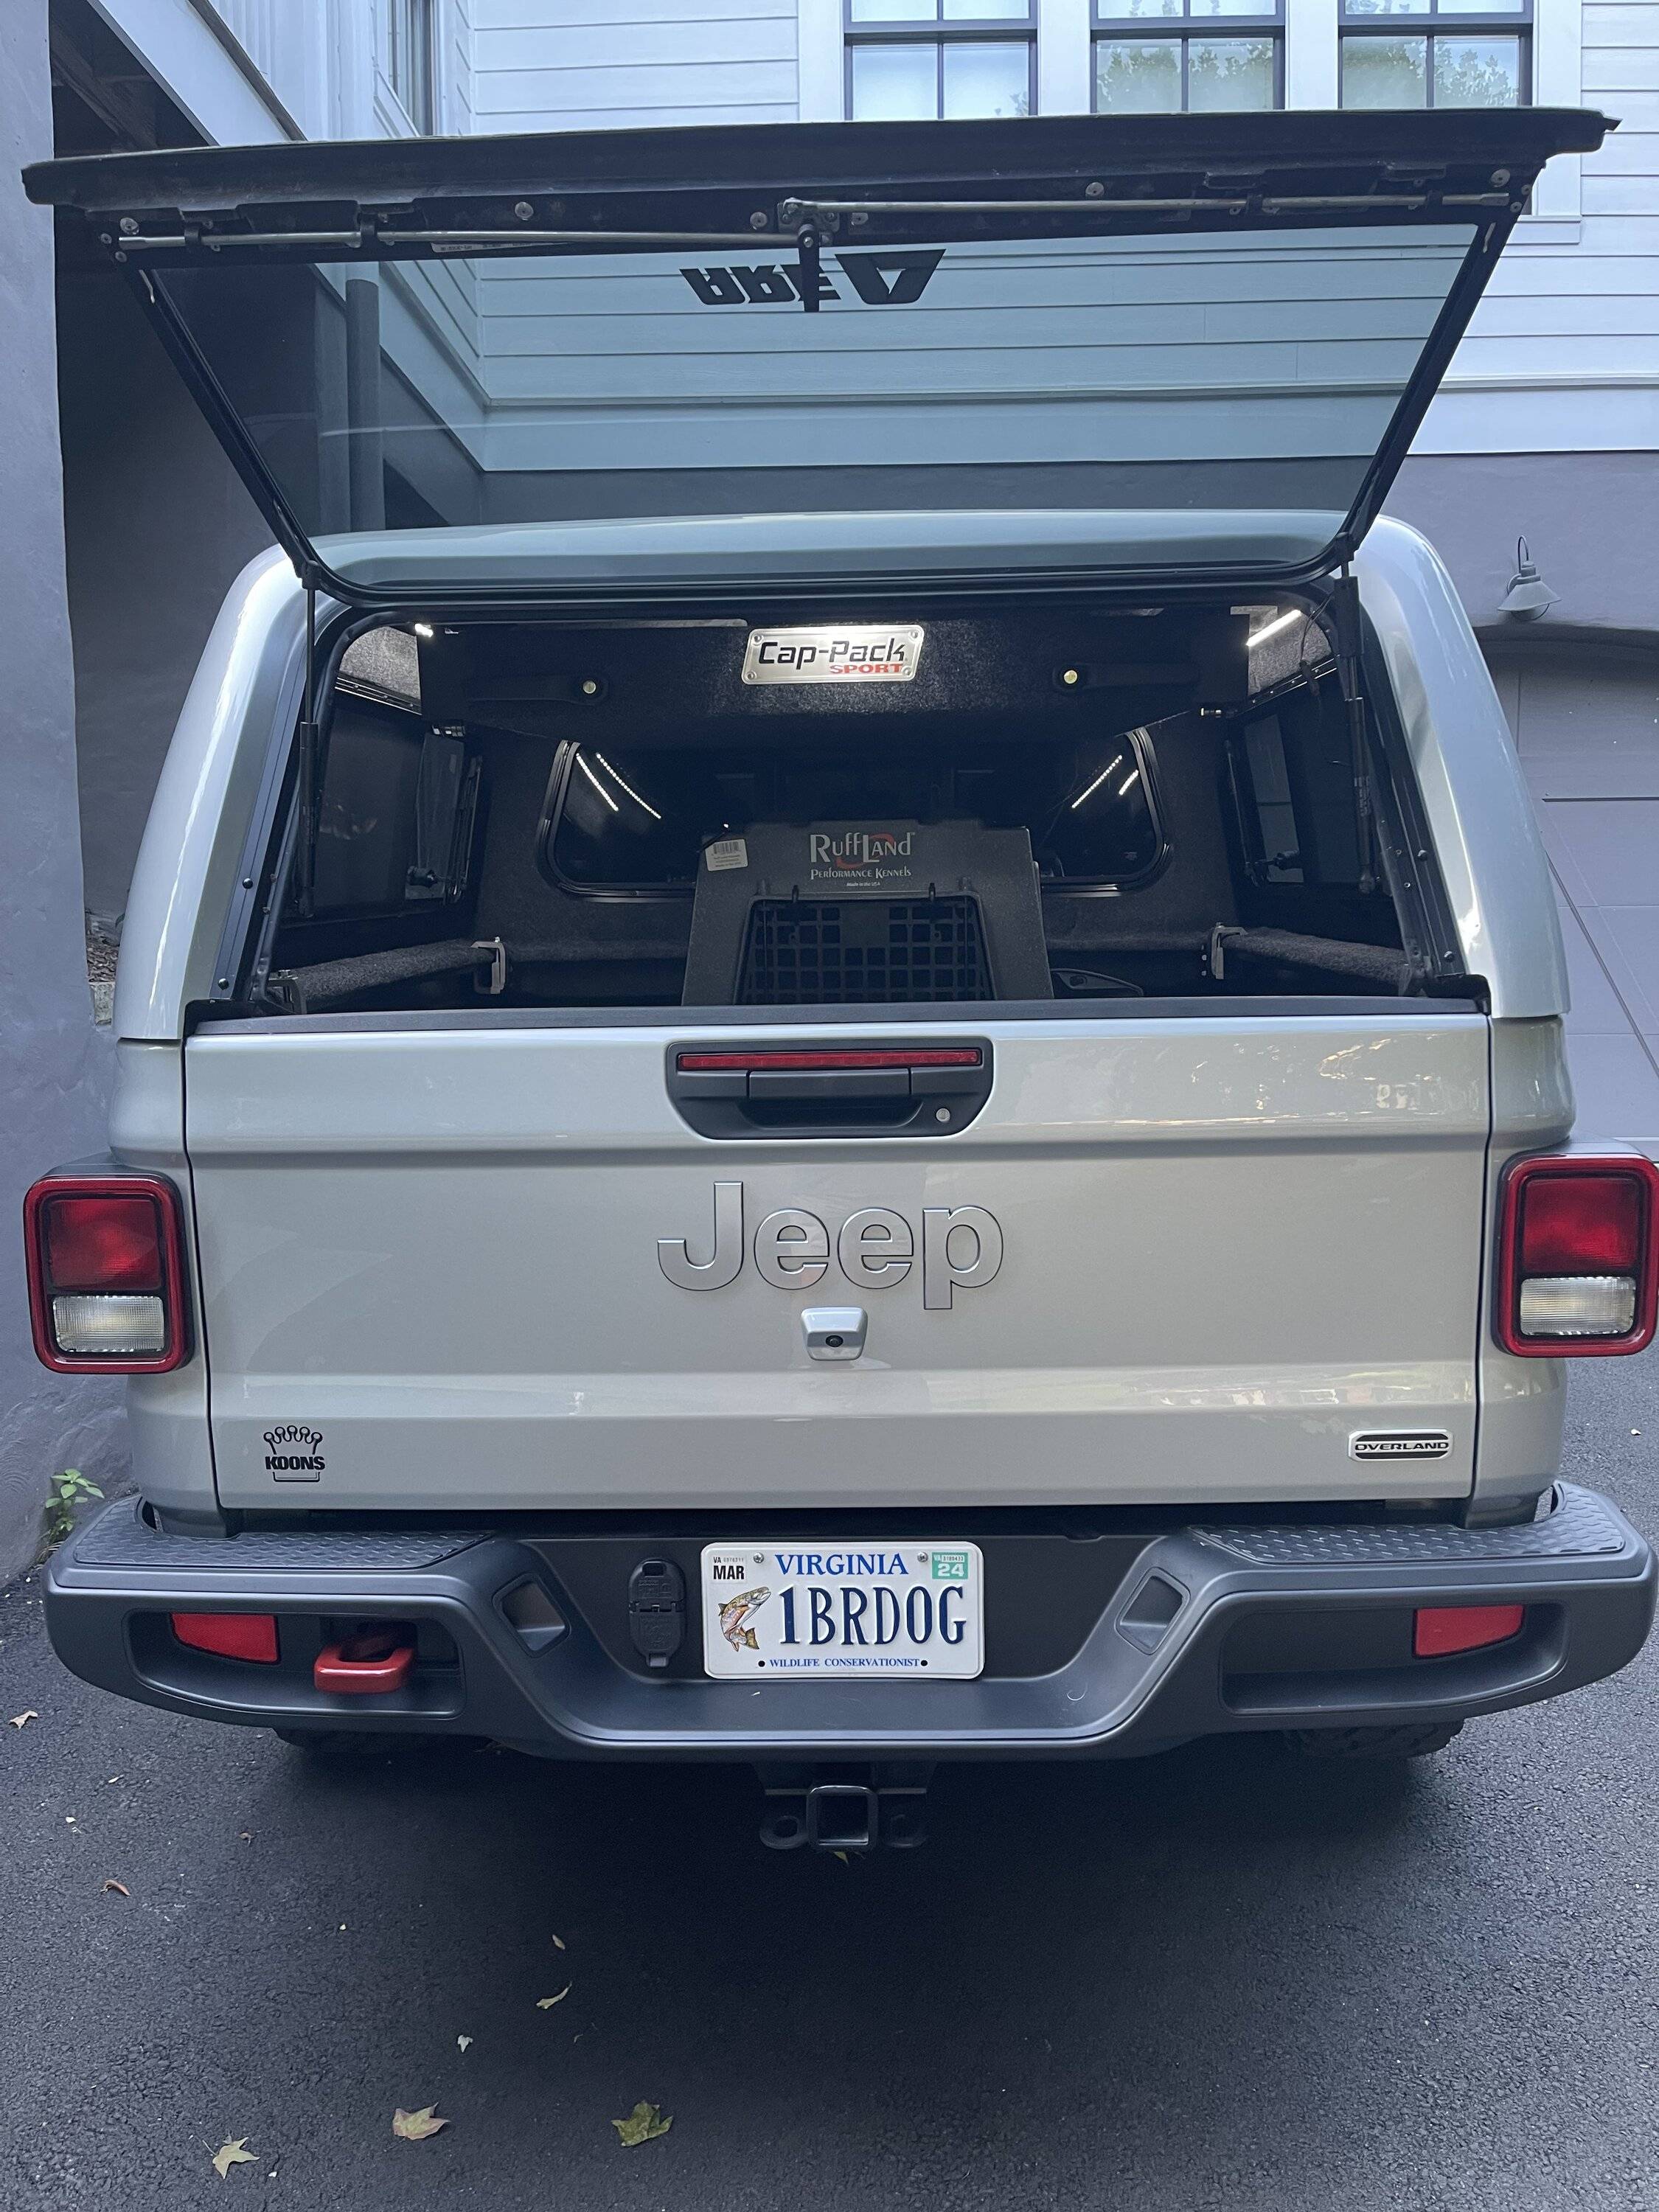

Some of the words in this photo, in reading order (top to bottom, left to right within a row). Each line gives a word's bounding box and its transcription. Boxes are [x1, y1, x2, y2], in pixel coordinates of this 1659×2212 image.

[759, 638, 905, 669] Cap-Pack
[830, 663, 903, 674] SPORT
[657, 1180, 1004, 1310] Jeep
[1354, 1441, 1449, 1451] OVERLAND
[265, 1455, 325, 1470] KOONS
[775, 1553, 908, 1576] VIRGINIA
[938, 1563, 964, 1576] 24
[713, 1565, 745, 1579] MAR
[779, 1585, 967, 1646] 1BRDOG
[770, 1658, 819, 1667] WILDLIFE
[824, 1658, 920, 1667] CONSERVATIONIST
